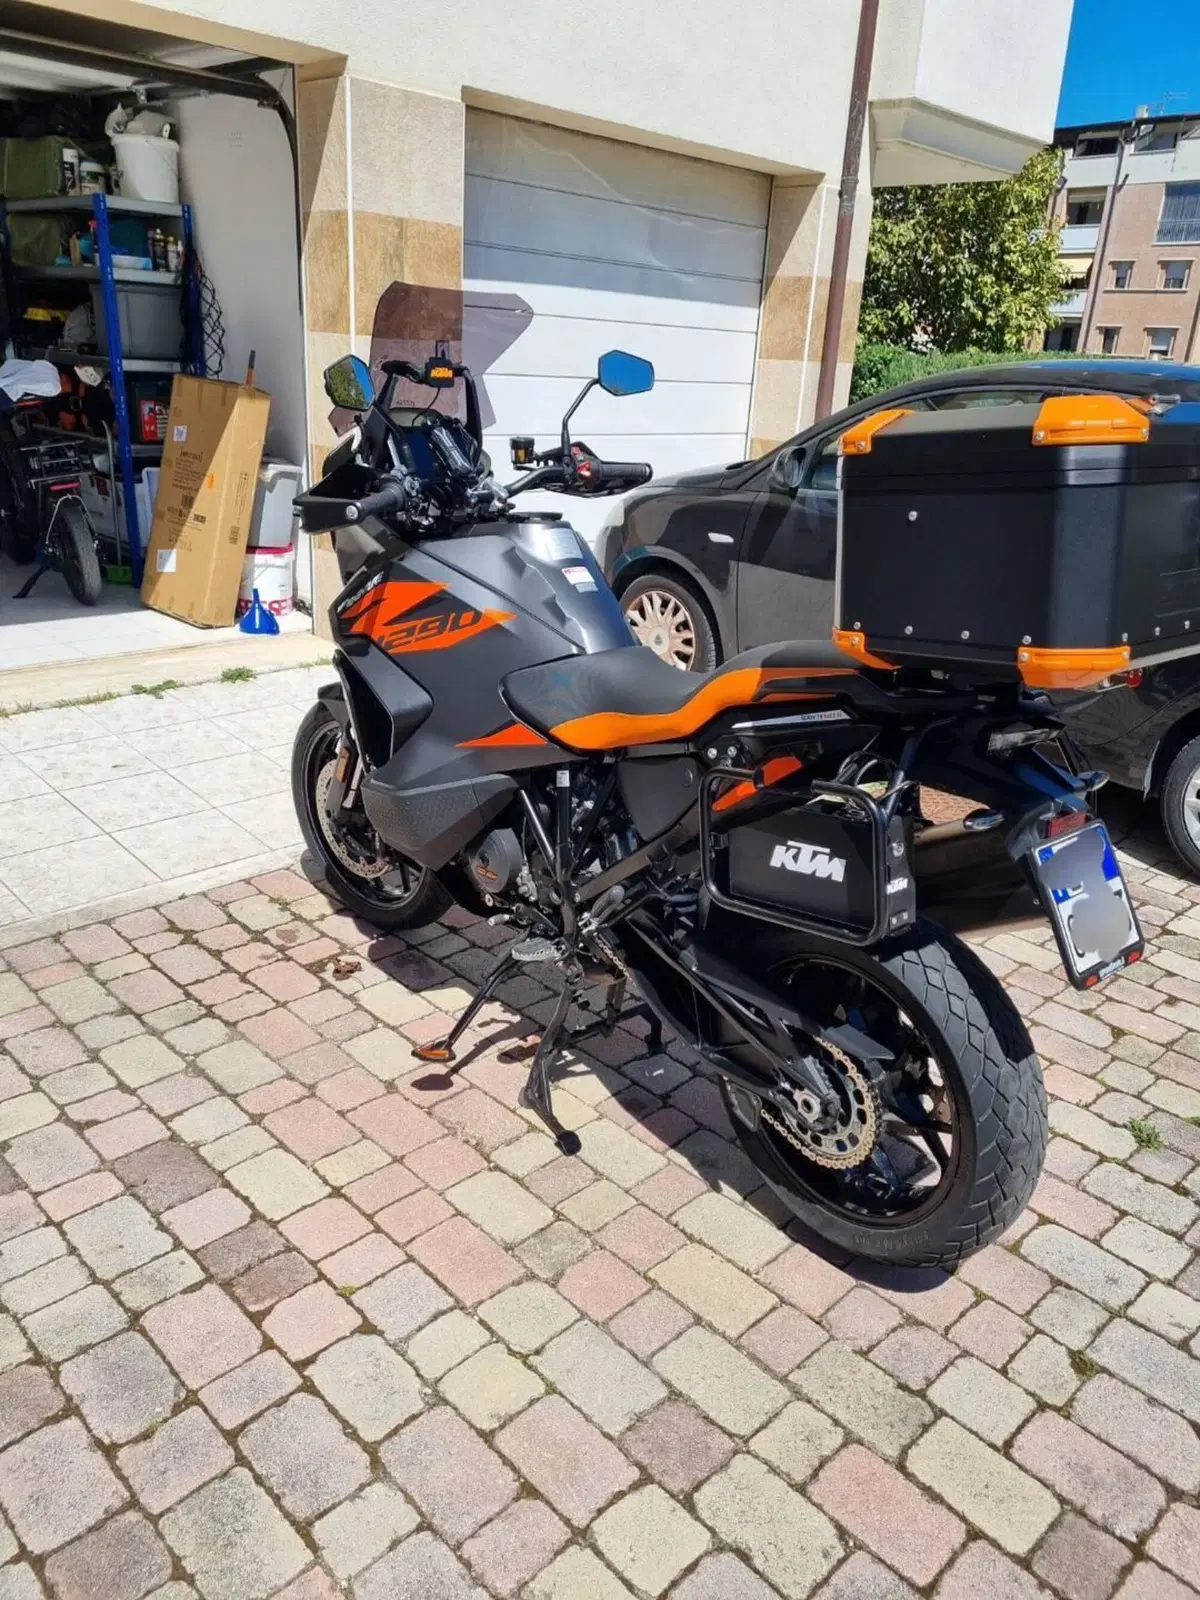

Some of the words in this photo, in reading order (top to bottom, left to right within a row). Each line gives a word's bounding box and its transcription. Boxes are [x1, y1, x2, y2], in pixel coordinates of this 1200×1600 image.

[375, 609, 482, 650] 1290
[769, 840, 847, 882] KTM
[886, 877, 909, 895] KTM
